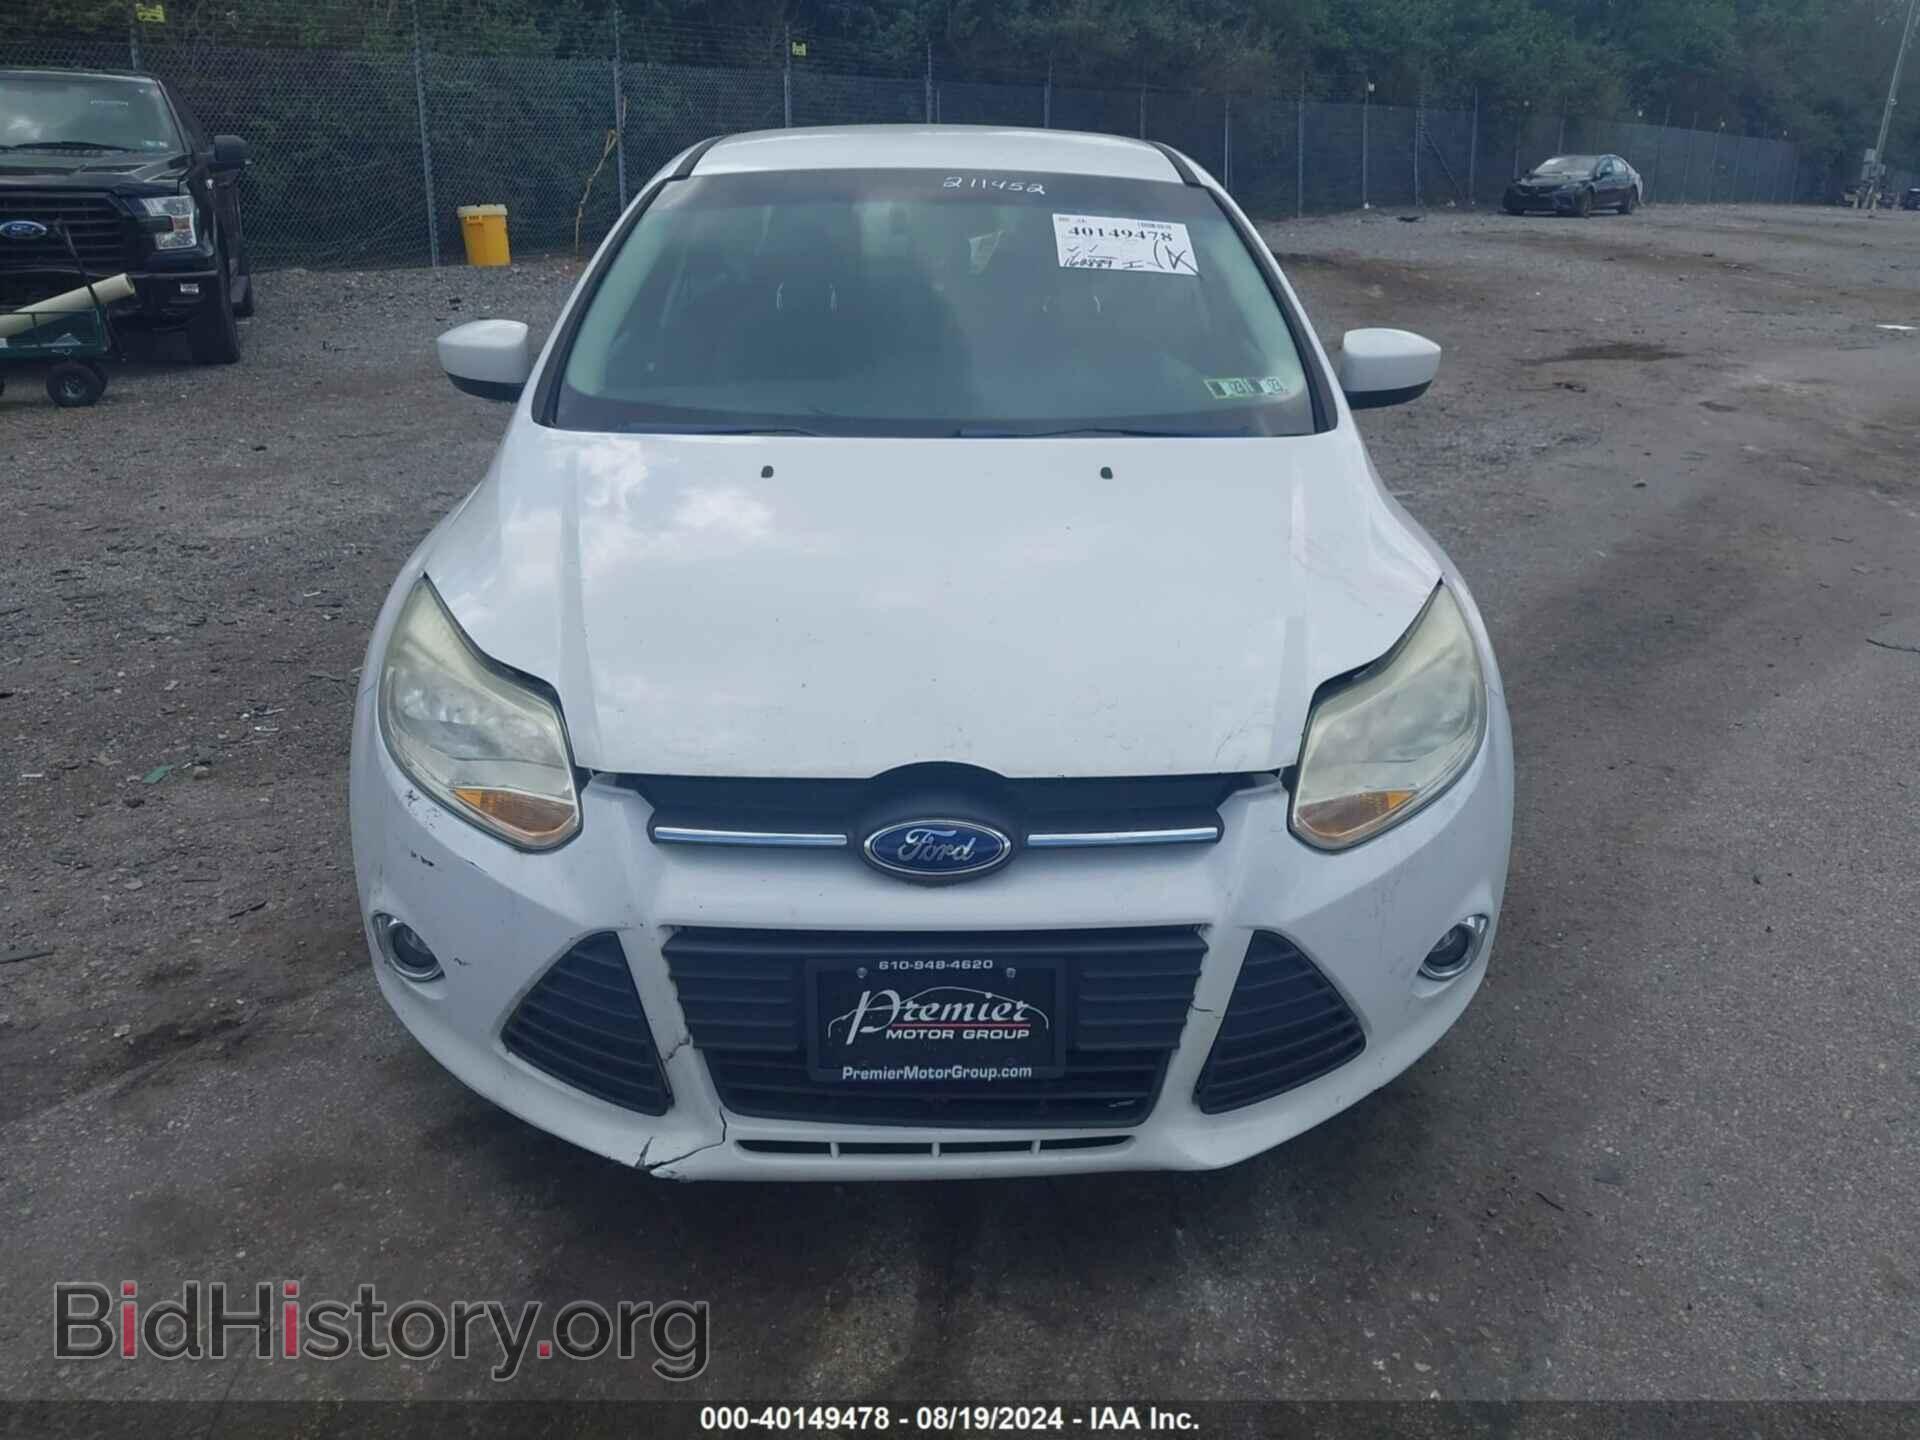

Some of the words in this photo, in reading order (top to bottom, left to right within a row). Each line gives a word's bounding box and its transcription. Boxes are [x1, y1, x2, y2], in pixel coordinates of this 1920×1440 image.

[943, 176, 1046, 195] 211452
[1068, 226, 1173, 241] 40149478
[898, 828, 977, 860] Ford
[878, 959, 994, 970] 610-948-4620
[846, 990, 1029, 1044] Premier
[886, 1029, 954, 1040] MOTOR
[962, 1029, 1030, 1040] GROUP
[842, 1065, 1032, 1081] PremierMotorGroup.com
